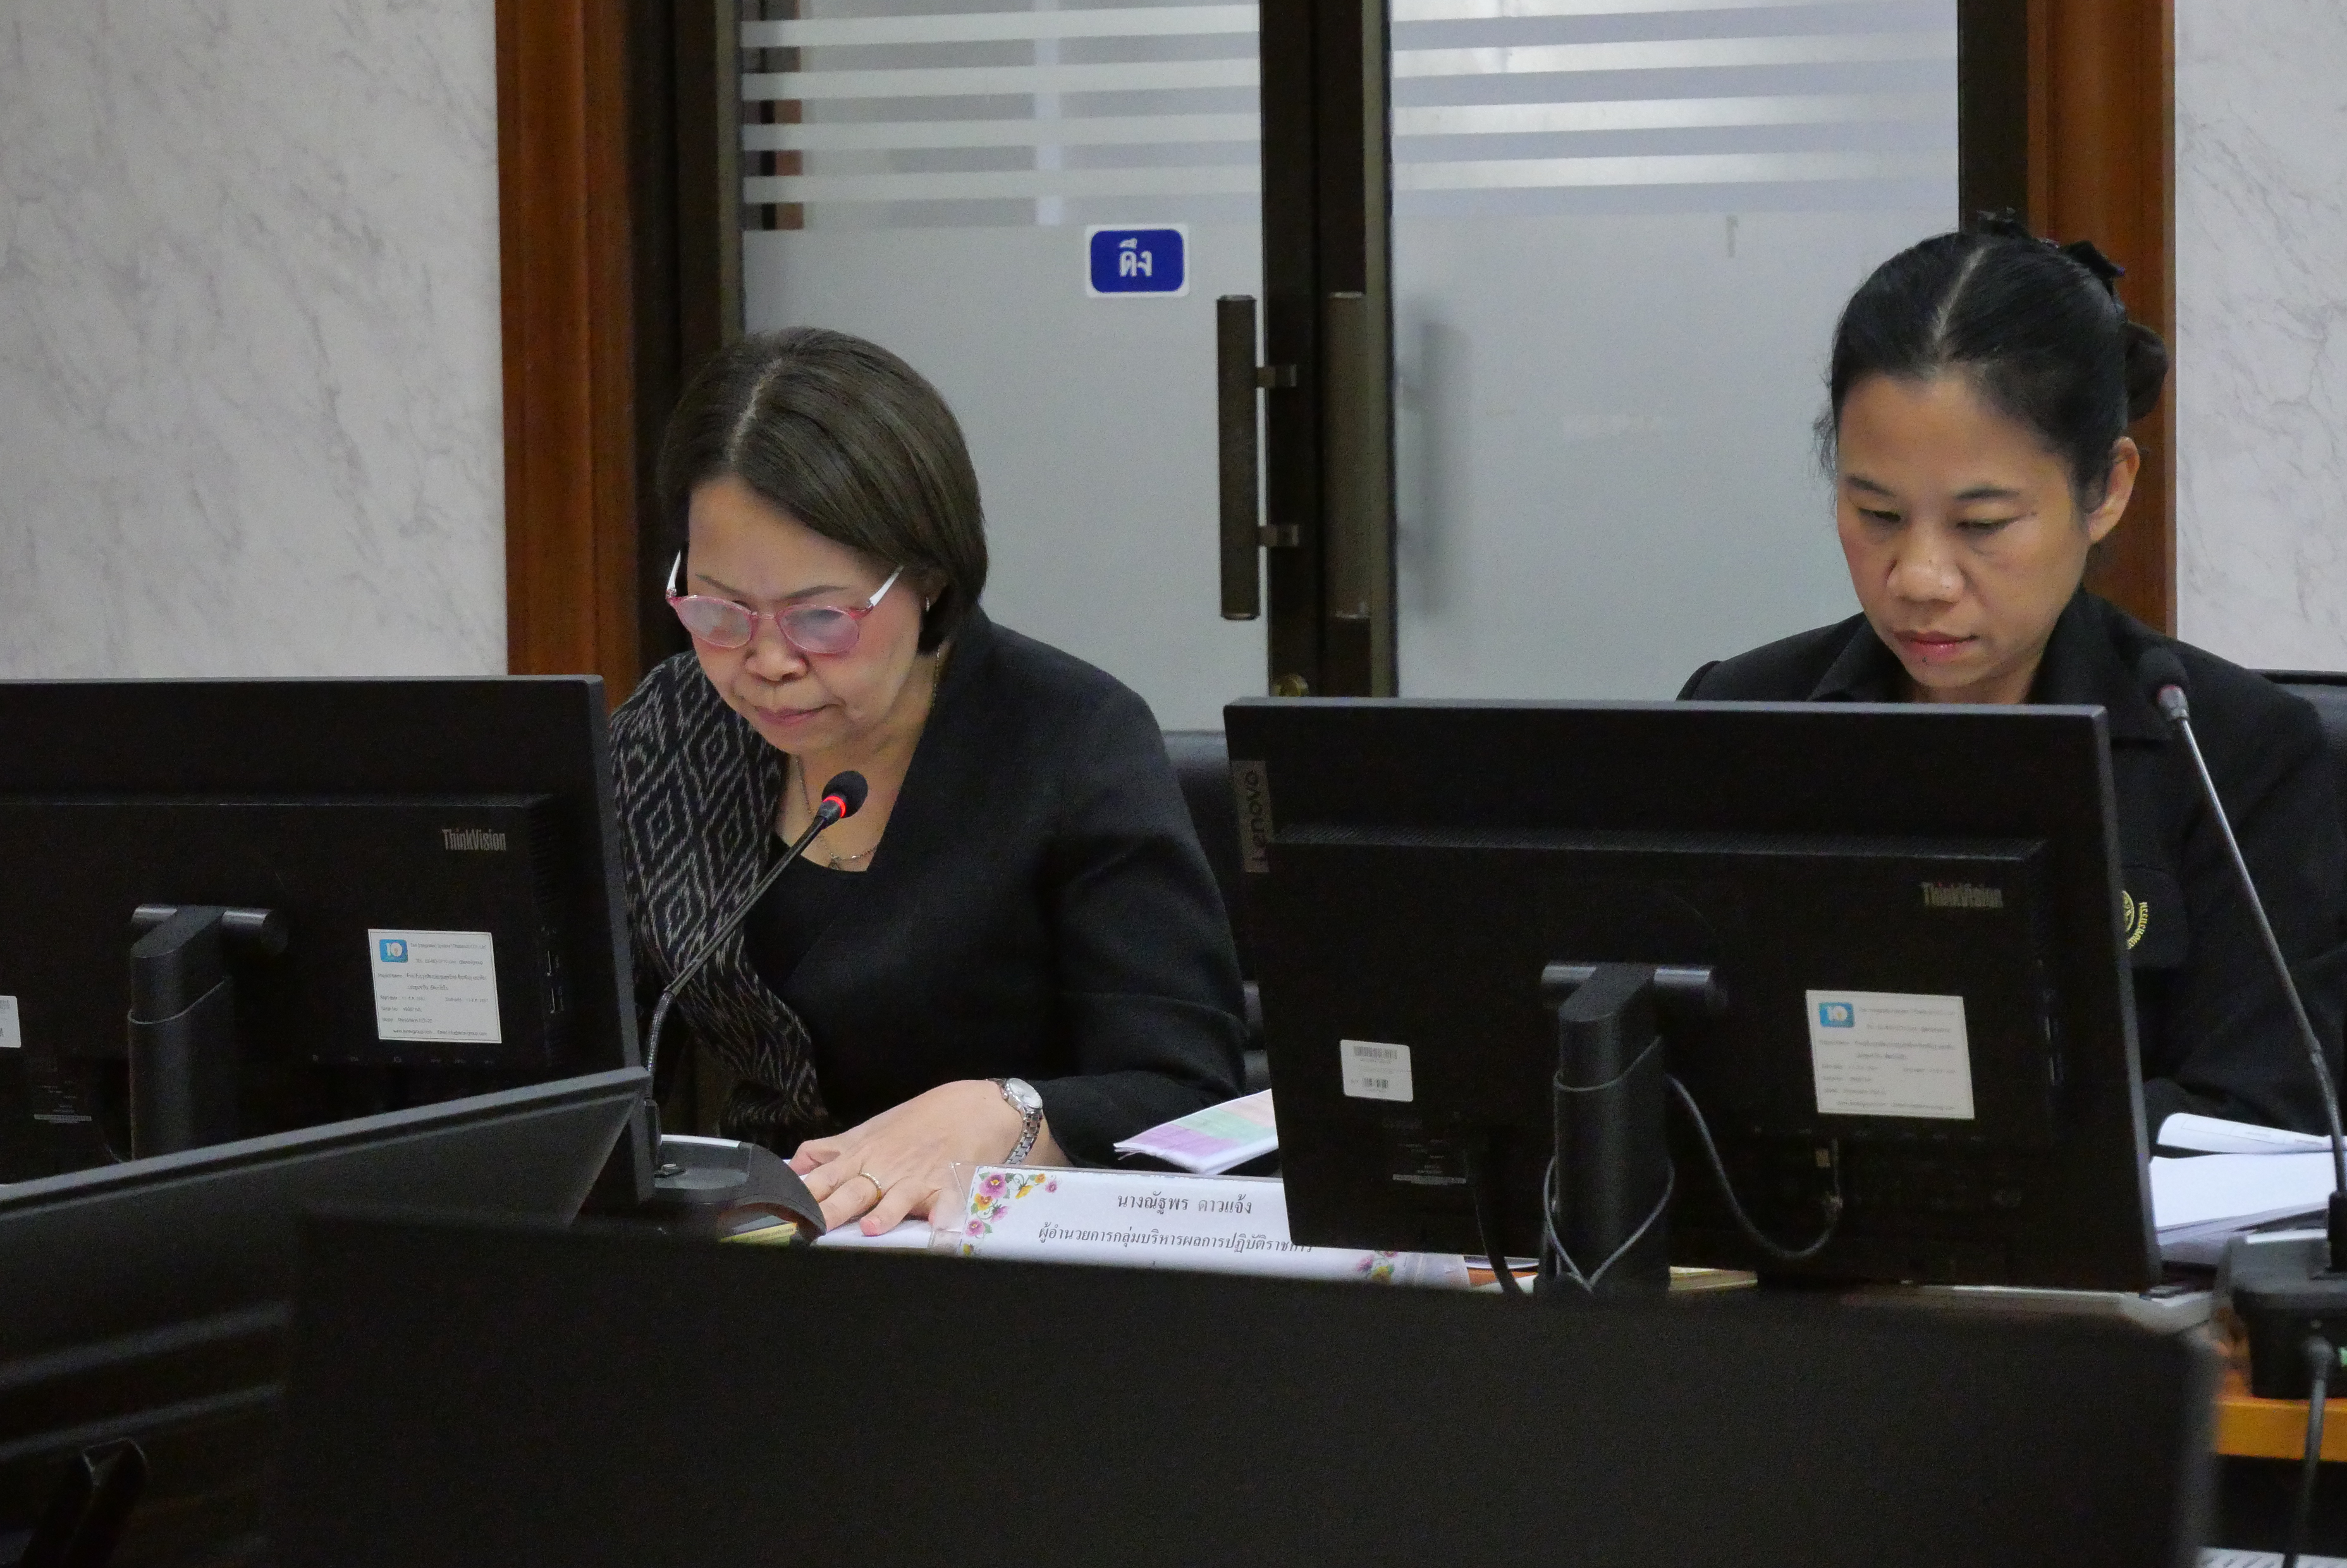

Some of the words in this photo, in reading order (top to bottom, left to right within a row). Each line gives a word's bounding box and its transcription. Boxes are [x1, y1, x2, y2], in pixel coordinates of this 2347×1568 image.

[1119, 238, 1153, 277] ดึง
[442, 828, 506, 851] ThinkVision
[1921, 881, 2003, 908] ThinkVision
[1118, 1191, 1189, 1215] นางณัฐพร
[1198, 1194, 1252, 1214] ดาวแจ้ง
